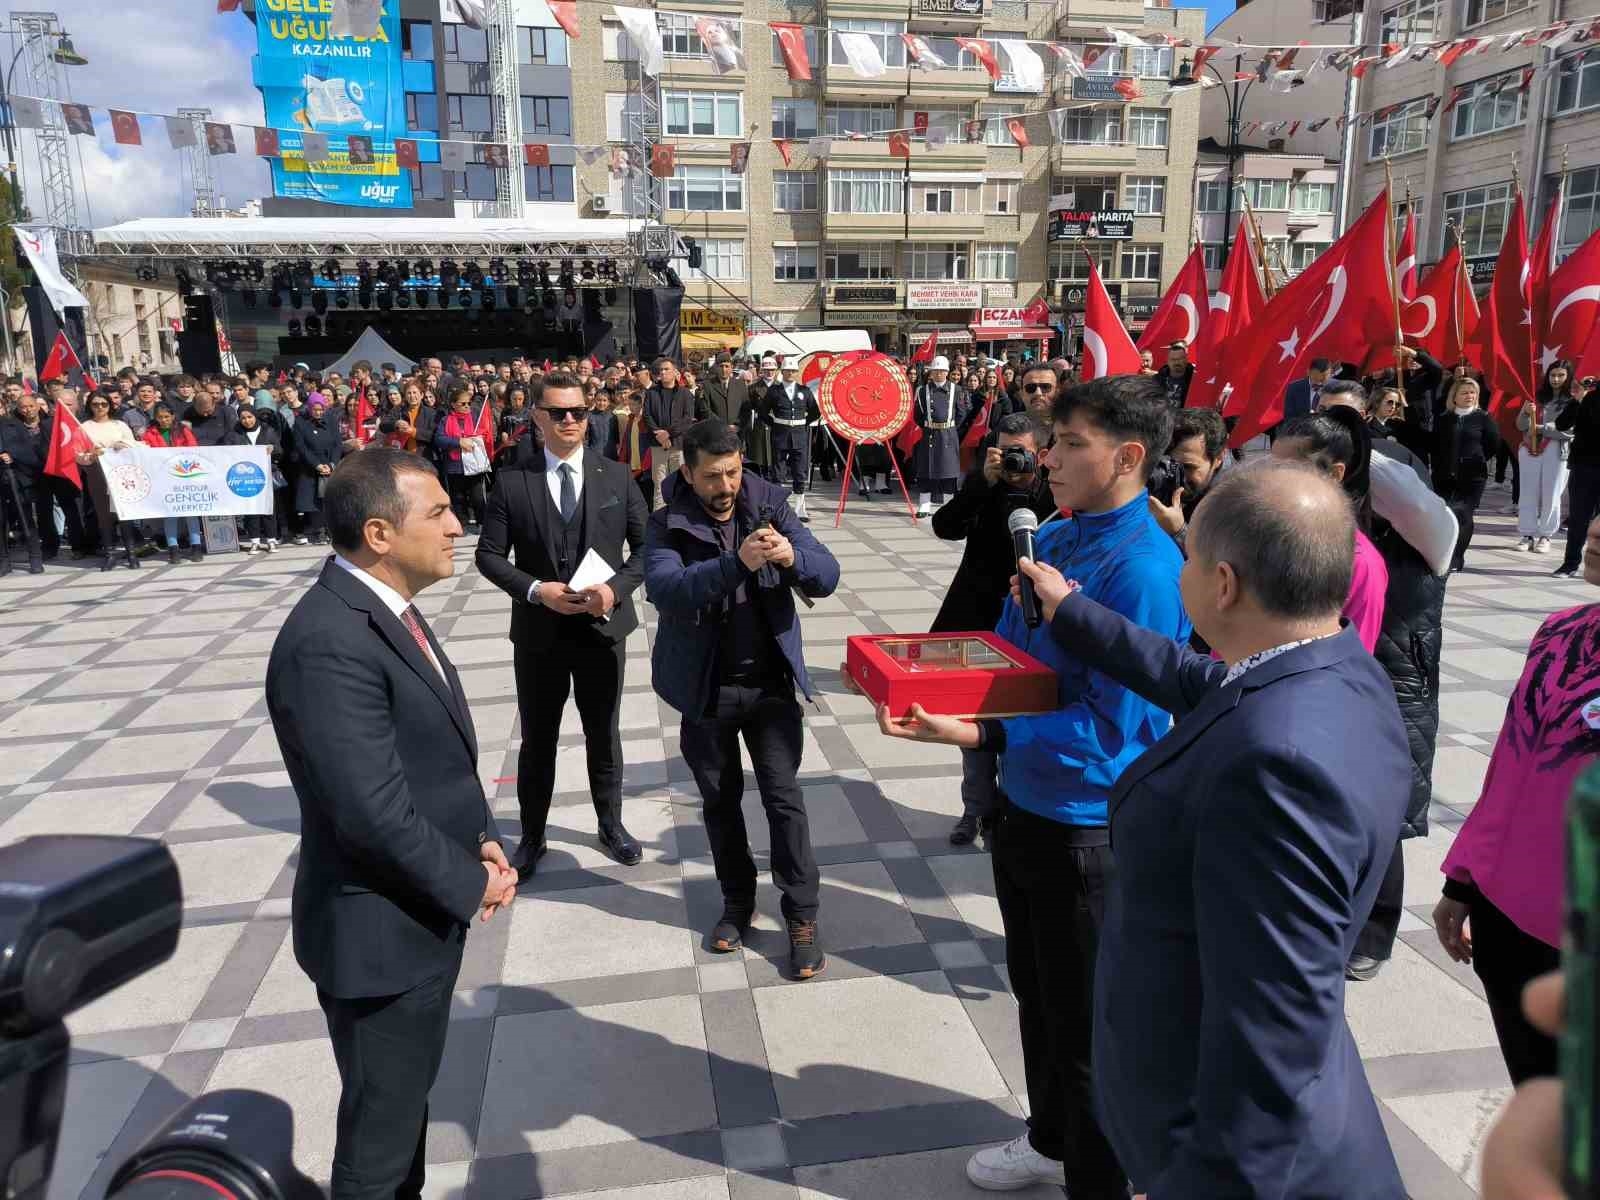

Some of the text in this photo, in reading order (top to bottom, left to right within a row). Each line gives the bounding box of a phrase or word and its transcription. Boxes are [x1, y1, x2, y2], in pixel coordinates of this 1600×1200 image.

[292, 43, 372, 58] KAZANILIR
[361, 181, 399, 200] uğur
[1062, 211, 1092, 221] TALAY
[911, 290, 939, 298] MEHMET
[960, 290, 978, 298] KARA
